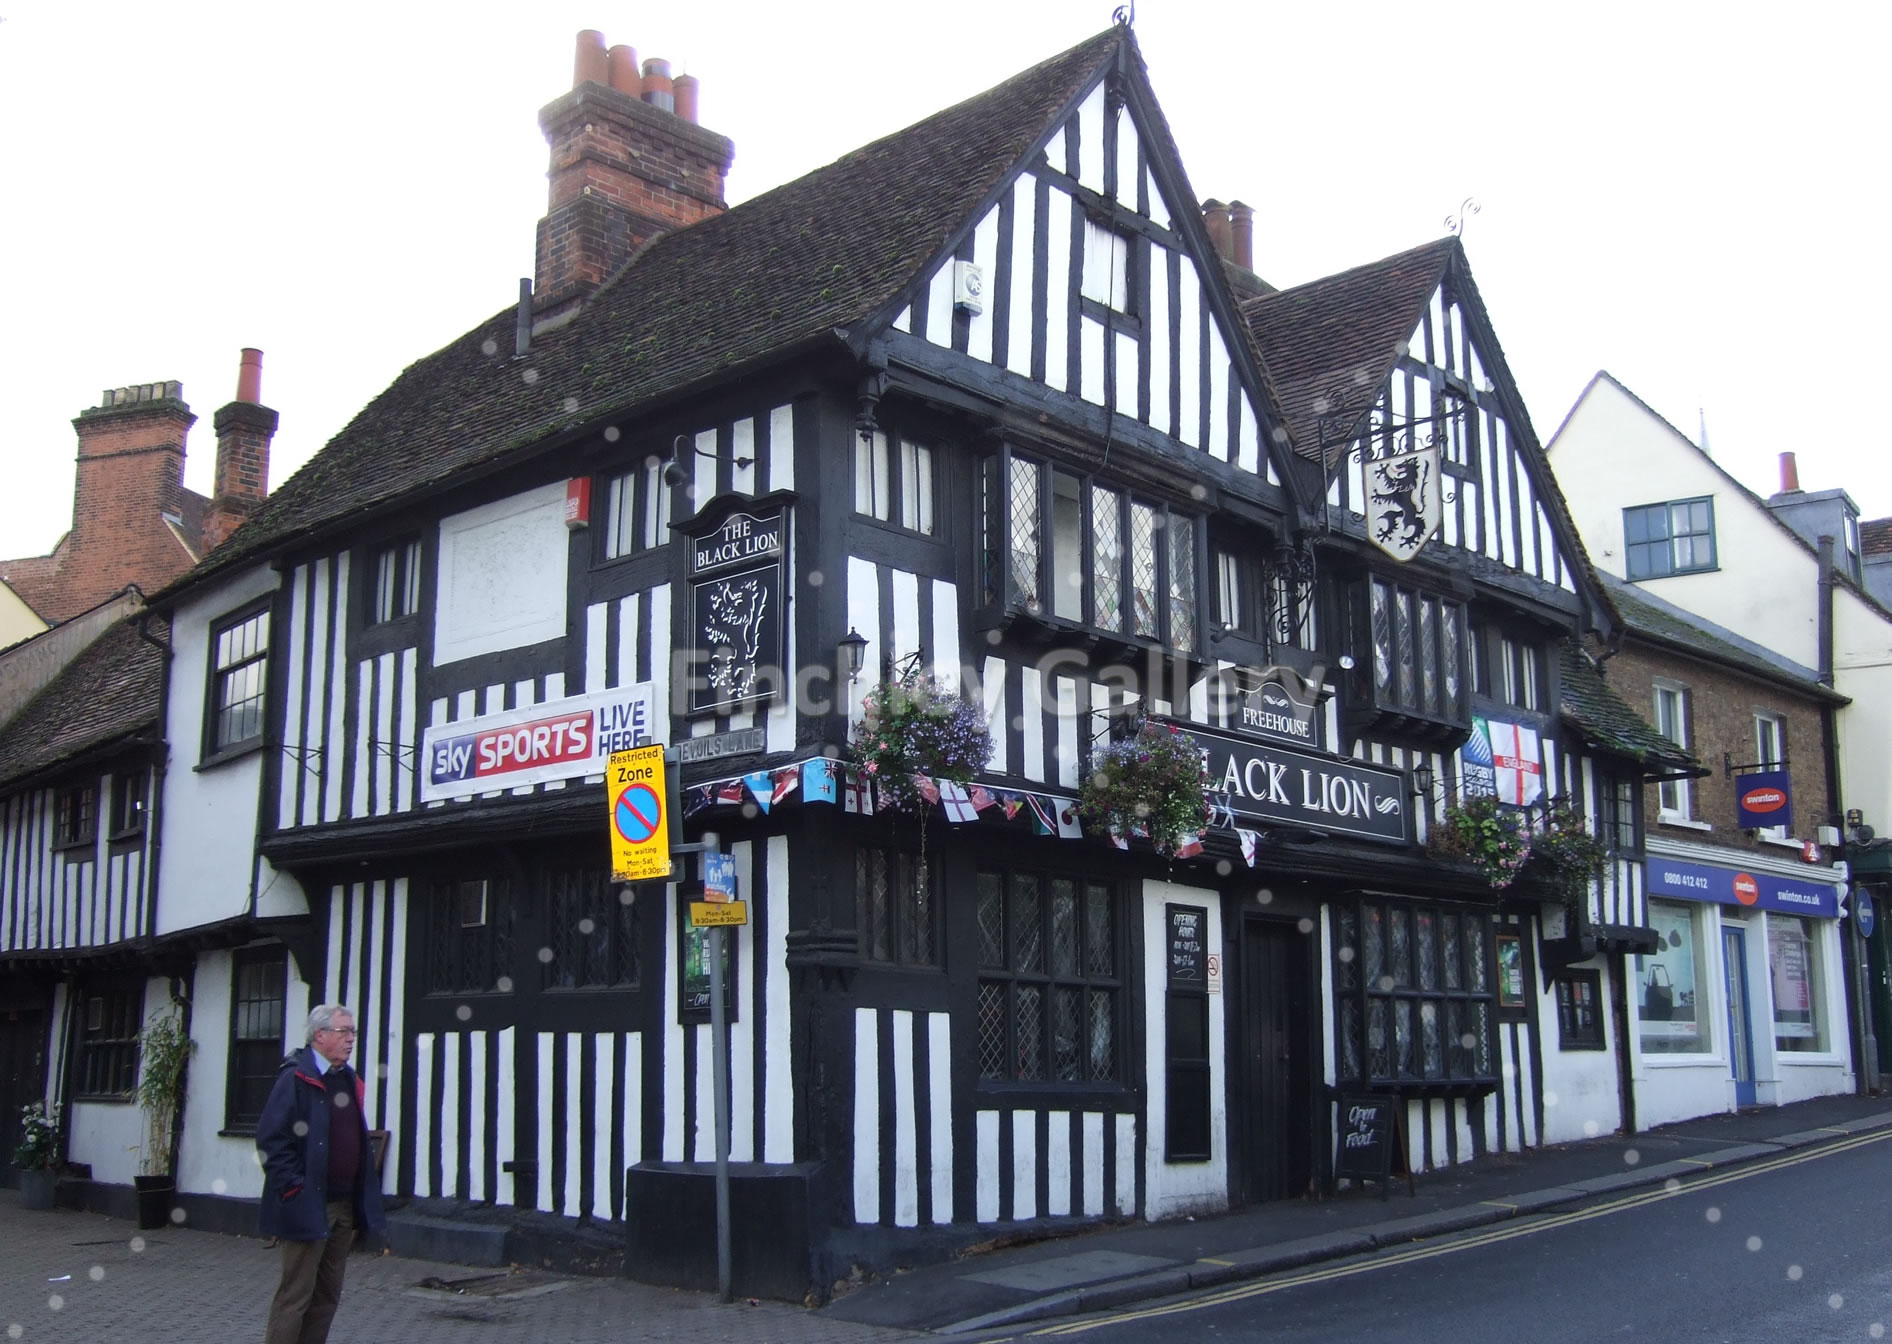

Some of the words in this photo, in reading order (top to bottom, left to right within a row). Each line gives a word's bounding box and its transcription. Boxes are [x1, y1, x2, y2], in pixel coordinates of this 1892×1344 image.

[723, 521, 751, 542] THE
[697, 541, 741, 567] BLACK
[745, 531, 779, 555] LION
[600, 700, 645, 732] LIVE
[1243, 707, 1310, 738] FREEHOUSE
[479, 719, 588, 770] SPORTS
[598, 728, 645, 757] HERE
[728, 731, 761, 752] LANE
[610, 748, 659, 765] Restricted
[618, 767, 653, 783] Zone
[1463, 762, 1494, 780] RUGBY
[1198, 747, 1291, 806] LACK
[1300, 768, 1372, 820] LION
[1746, 794, 1779, 804] swinton
[634, 847, 657, 855] waiting
[1664, 872, 1681, 885] 0800
[1682, 875, 1695, 887] 412
[1695, 878, 1708, 889] 412
[1735, 881, 1755, 892] swinton
[1777, 890, 1821, 906] swinton.co.uk
